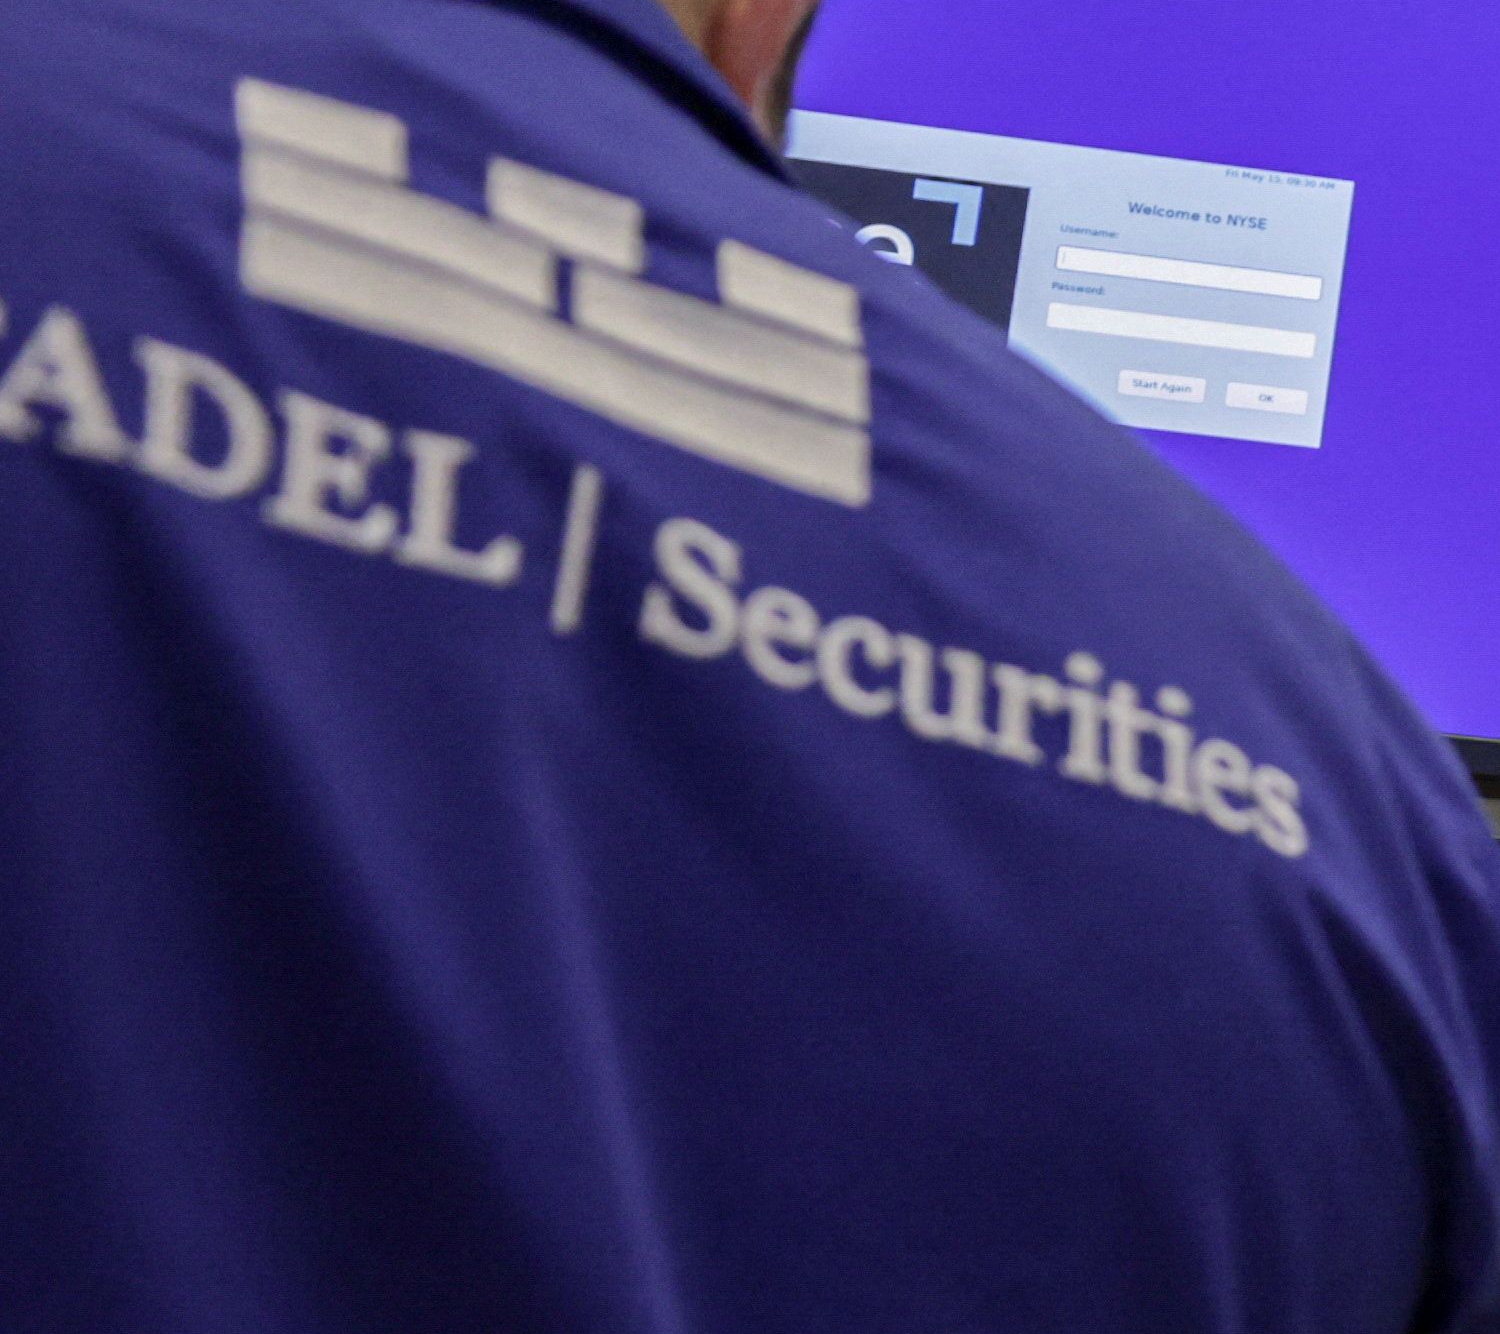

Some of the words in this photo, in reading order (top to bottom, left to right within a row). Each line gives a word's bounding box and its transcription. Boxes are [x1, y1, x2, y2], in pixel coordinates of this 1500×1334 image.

[1242, 170, 1264, 183] May
[1128, 200, 1200, 222] Welcome
[1205, 210, 1222, 224] to
[1227, 213, 1268, 230] NYSE
[1060, 223, 1120, 239] Username:
[1052, 281, 1106, 296] Password:
[1132, 377, 1158, 391] Start
[1160, 380, 1193, 395] Again
[1258, 392, 1274, 404] OK
[0, 299, 522, 587] ADEL
[638, 517, 1309, 859] Securities
